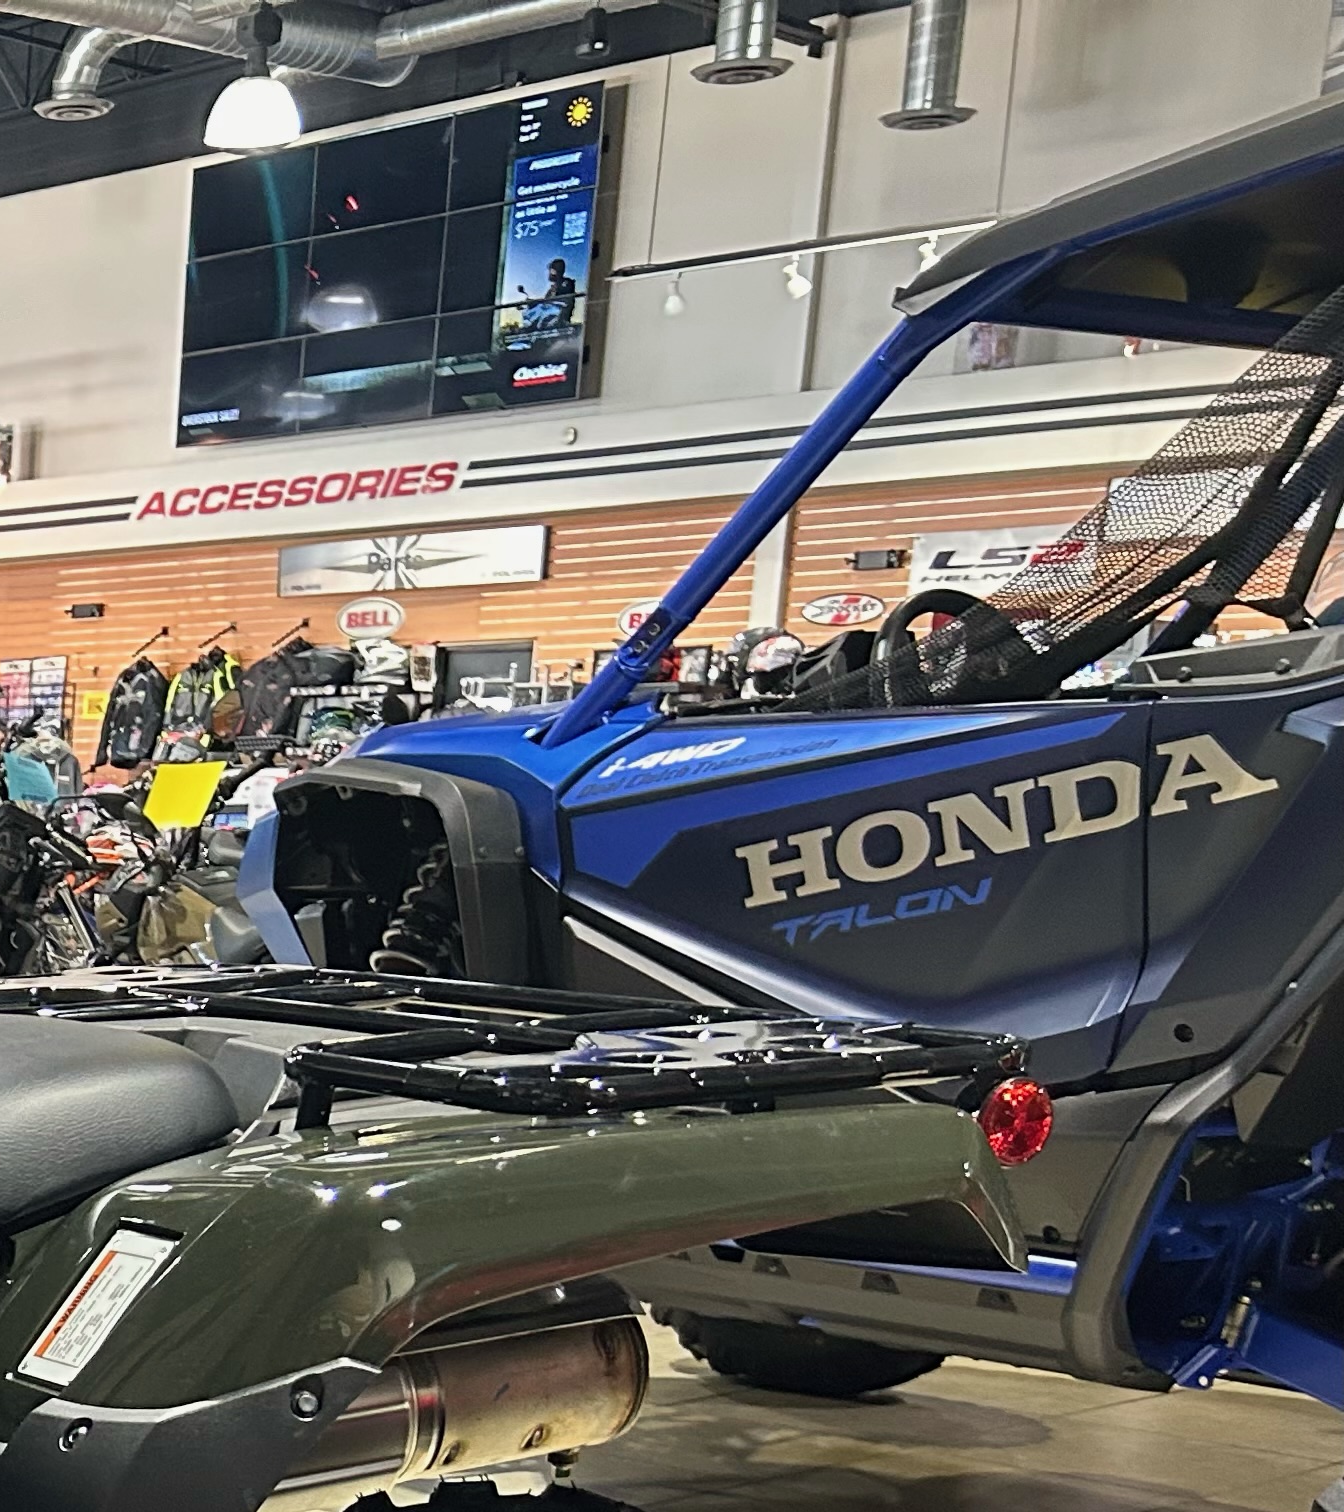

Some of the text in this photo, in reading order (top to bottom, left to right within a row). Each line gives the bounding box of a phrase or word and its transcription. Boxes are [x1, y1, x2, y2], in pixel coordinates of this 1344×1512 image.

[137, 461, 459, 520] ACCESSORIES
[345, 609, 393, 629] BELL
[734, 733, 1279, 909] HONDA
[772, 877, 993, 946] TALON
